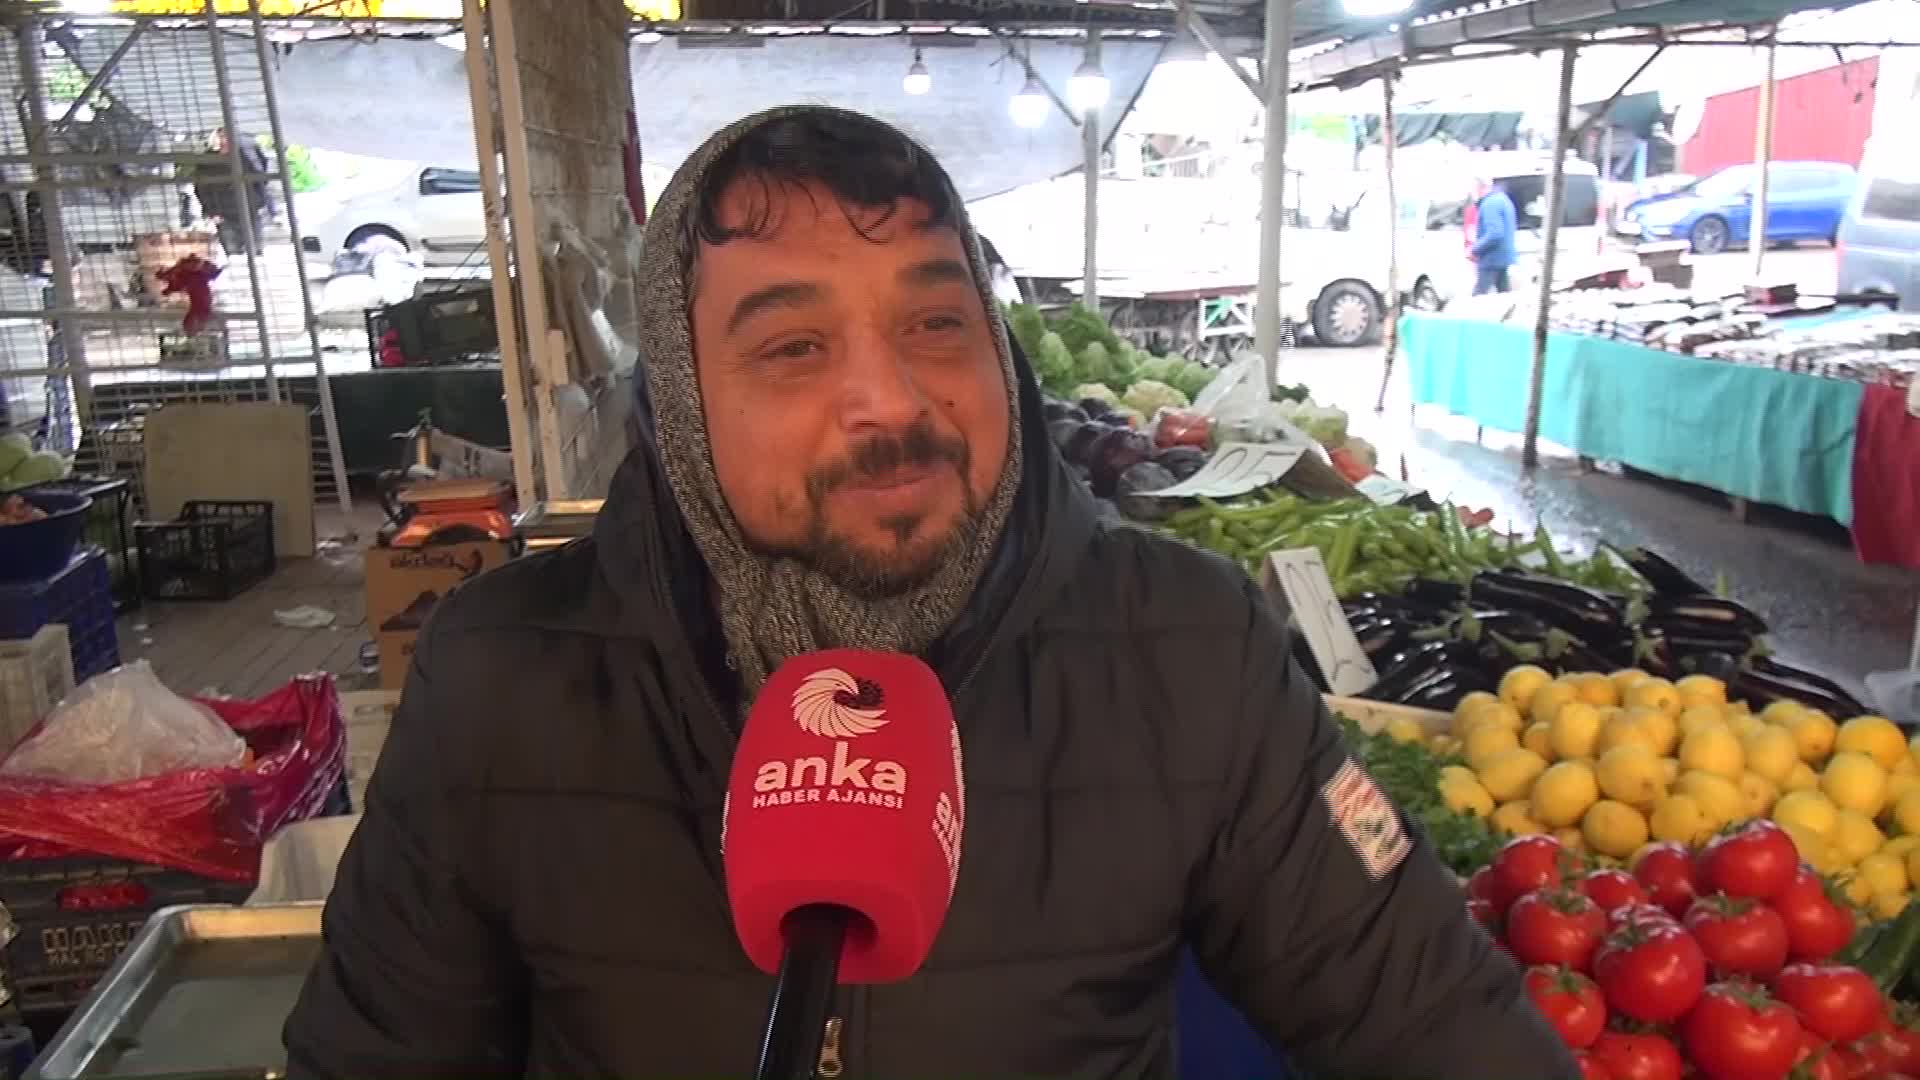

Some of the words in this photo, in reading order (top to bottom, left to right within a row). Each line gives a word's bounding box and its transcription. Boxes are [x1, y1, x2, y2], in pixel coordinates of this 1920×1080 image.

[754, 741, 907, 794] anka
[753, 788, 821, 809] HABER
[826, 788, 904, 809] AJANSI
